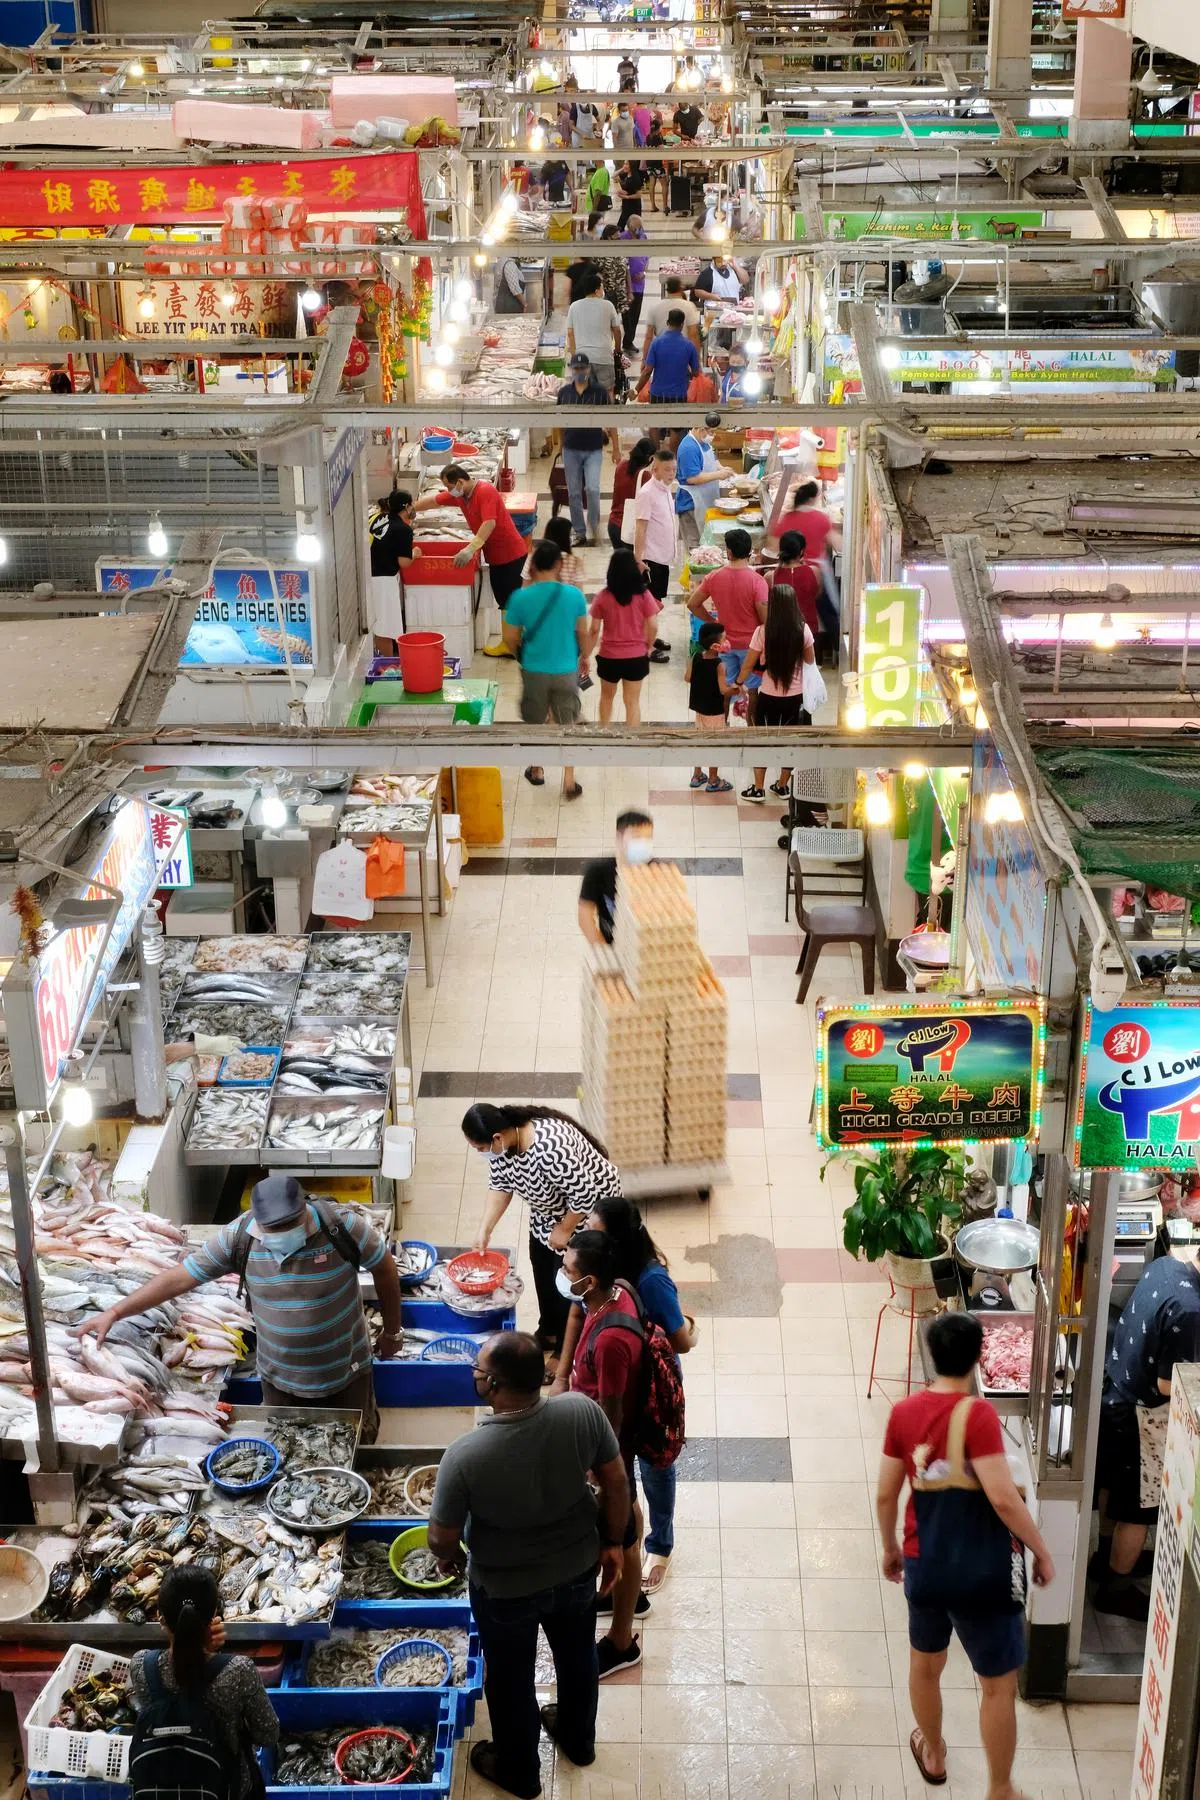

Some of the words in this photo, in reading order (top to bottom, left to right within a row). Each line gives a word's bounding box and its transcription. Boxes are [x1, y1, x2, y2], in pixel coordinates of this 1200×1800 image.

[636, 8, 649, 16] EXIT
[915, 223, 925, 231] &
[136, 322, 159, 334] LEE
[163, 322, 186, 334] YIT
[1070, 352, 1116, 361] HALAL
[938, 360, 990, 370] BOO
[902, 371, 950, 379] Pembekal
[1012, 371, 1036, 379] Beku
[1041, 371, 1068, 380] Ayam
[1072, 371, 1098, 379] Halal
[151, 813, 178, 849] 業
[851, 1028, 875, 1053] 劉
[1110, 1029, 1141, 1058] 劉
[910, 1074, 953, 1083] HALAL
[838, 1082, 1021, 1113] 上等牛肉
[841, 1114, 890, 1127] HIGH
[896, 1112, 964, 1127] GRADE
[970, 1109, 1021, 1124] BEEF
[1126, 1144, 1196, 1158] HALAL
[1160, 1489, 1182, 1585] FRESH
[1157, 1536, 1177, 1619] EGGS
